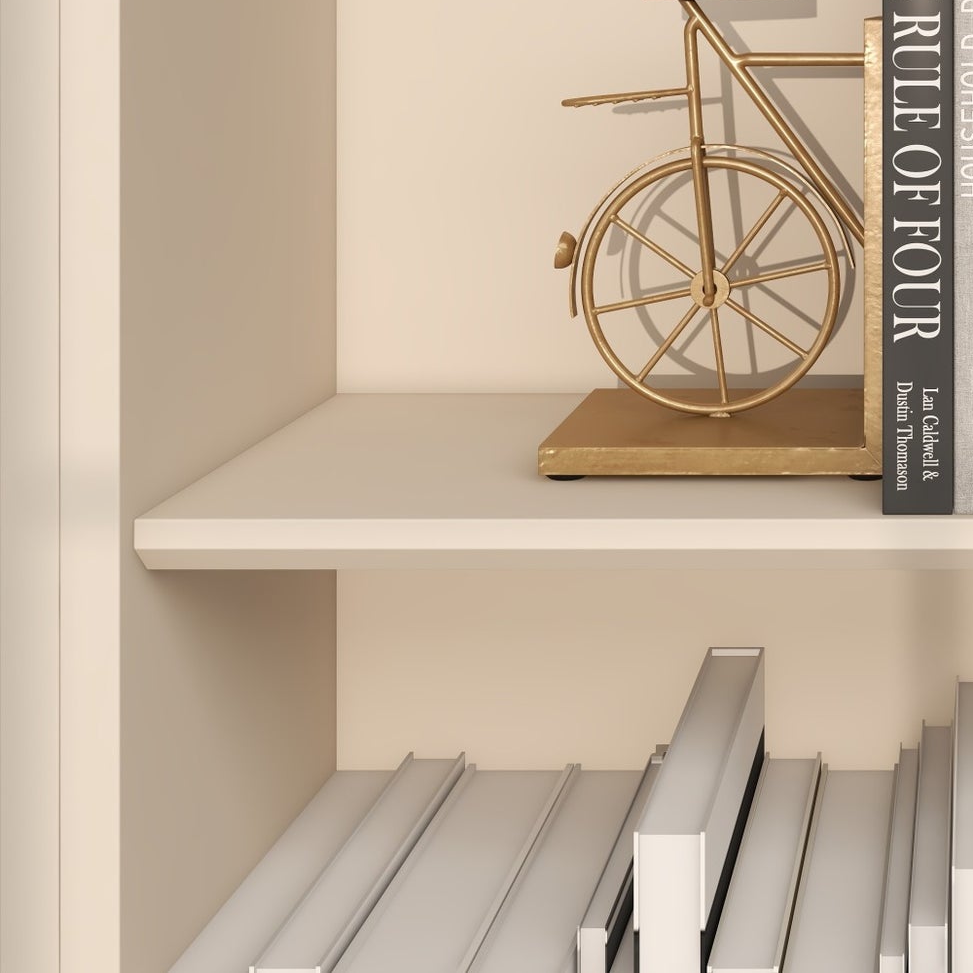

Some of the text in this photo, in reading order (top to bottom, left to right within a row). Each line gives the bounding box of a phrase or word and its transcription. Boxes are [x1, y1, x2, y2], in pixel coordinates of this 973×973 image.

[892, 11, 941, 132] RULE
[892, 144, 942, 206] OF
[892, 216, 942, 343] FOUR
[896, 381, 913, 491] Dustin Thomason
[922, 387, 940, 482] Lan Caldwell &
